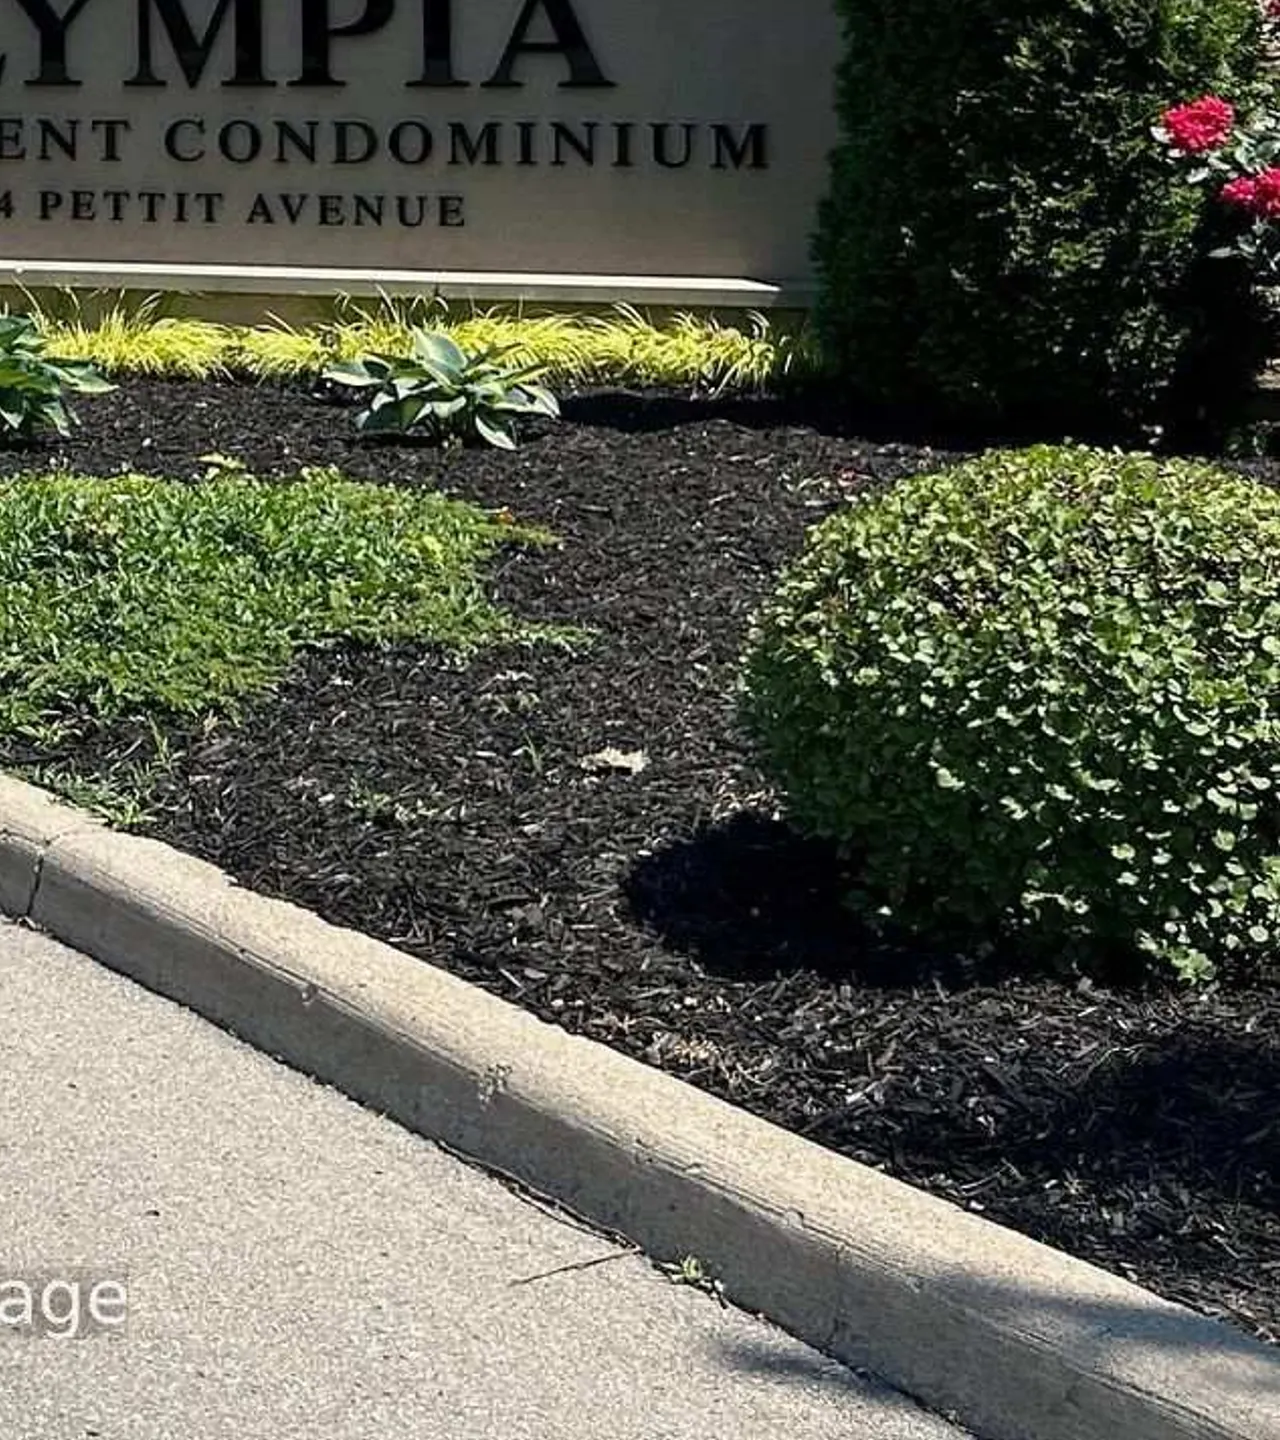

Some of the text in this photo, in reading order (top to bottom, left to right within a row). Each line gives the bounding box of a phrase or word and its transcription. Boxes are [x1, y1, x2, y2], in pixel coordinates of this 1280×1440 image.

[163, 117, 771, 170] CONDOMINIUM
[38, 189, 225, 224] PETTIT
[245, 192, 467, 229] AVENUE
